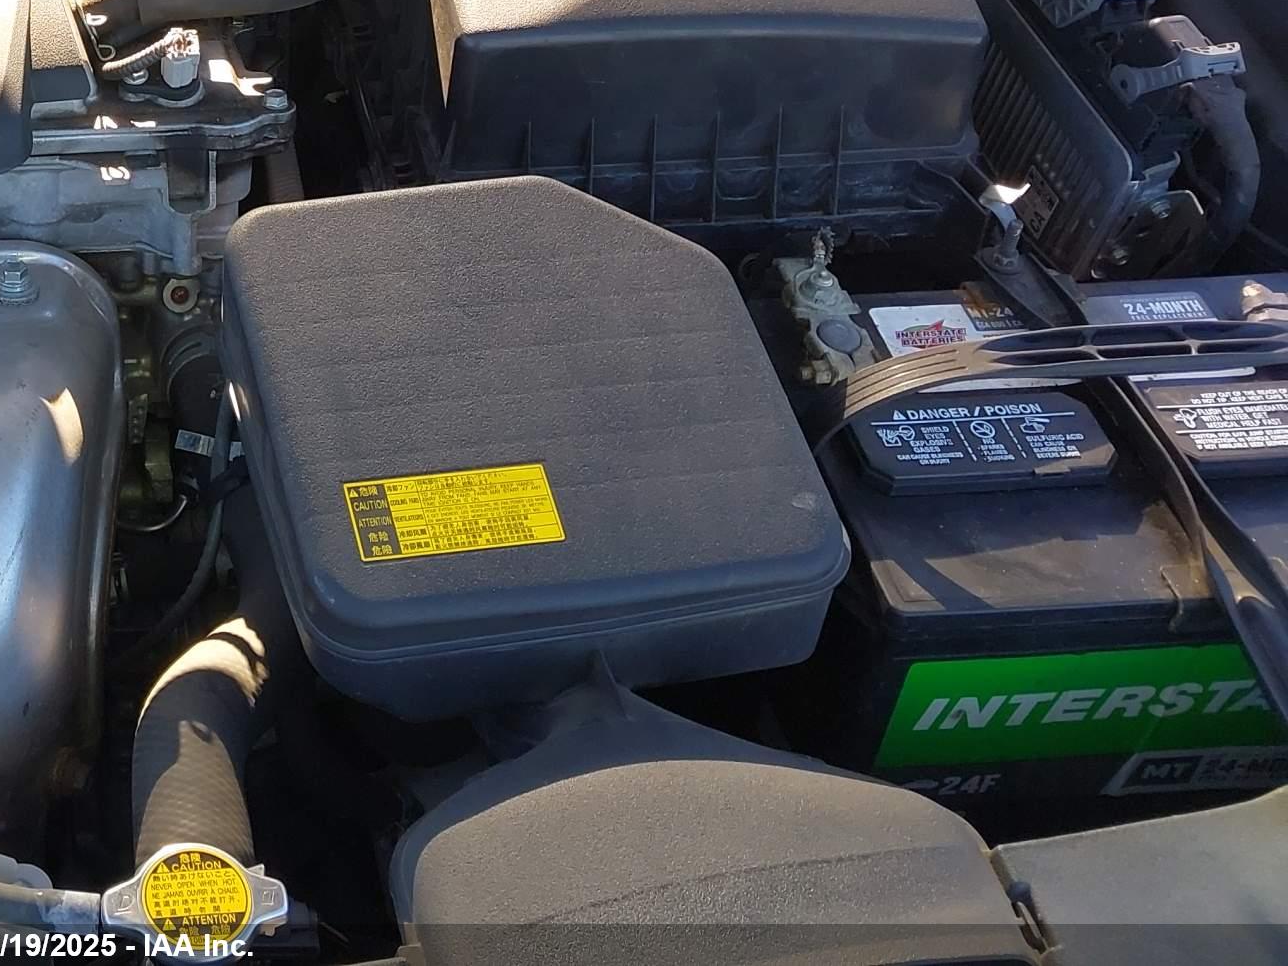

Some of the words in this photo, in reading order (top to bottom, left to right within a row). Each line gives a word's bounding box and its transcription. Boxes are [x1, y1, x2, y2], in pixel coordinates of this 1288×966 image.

[1123, 299, 1204, 315] 24-MONTH
[896, 328, 966, 339] INTERSTATE
[902, 336, 966, 346] BATTERIES
[906, 407, 970, 420] DANGER
[983, 403, 1043, 416] POISON
[353, 499, 389, 511] CAUTION
[359, 516, 392, 528] ATTENTION
[1142, 761, 1193, 779] MT
[938, 774, 1002, 796] 24F
[171, 861, 222, 872] CAUTION
[150, 883, 173, 891] NEVER
[199, 879, 218, 887] WHEN
[182, 913, 237, 926] ATTENTION
